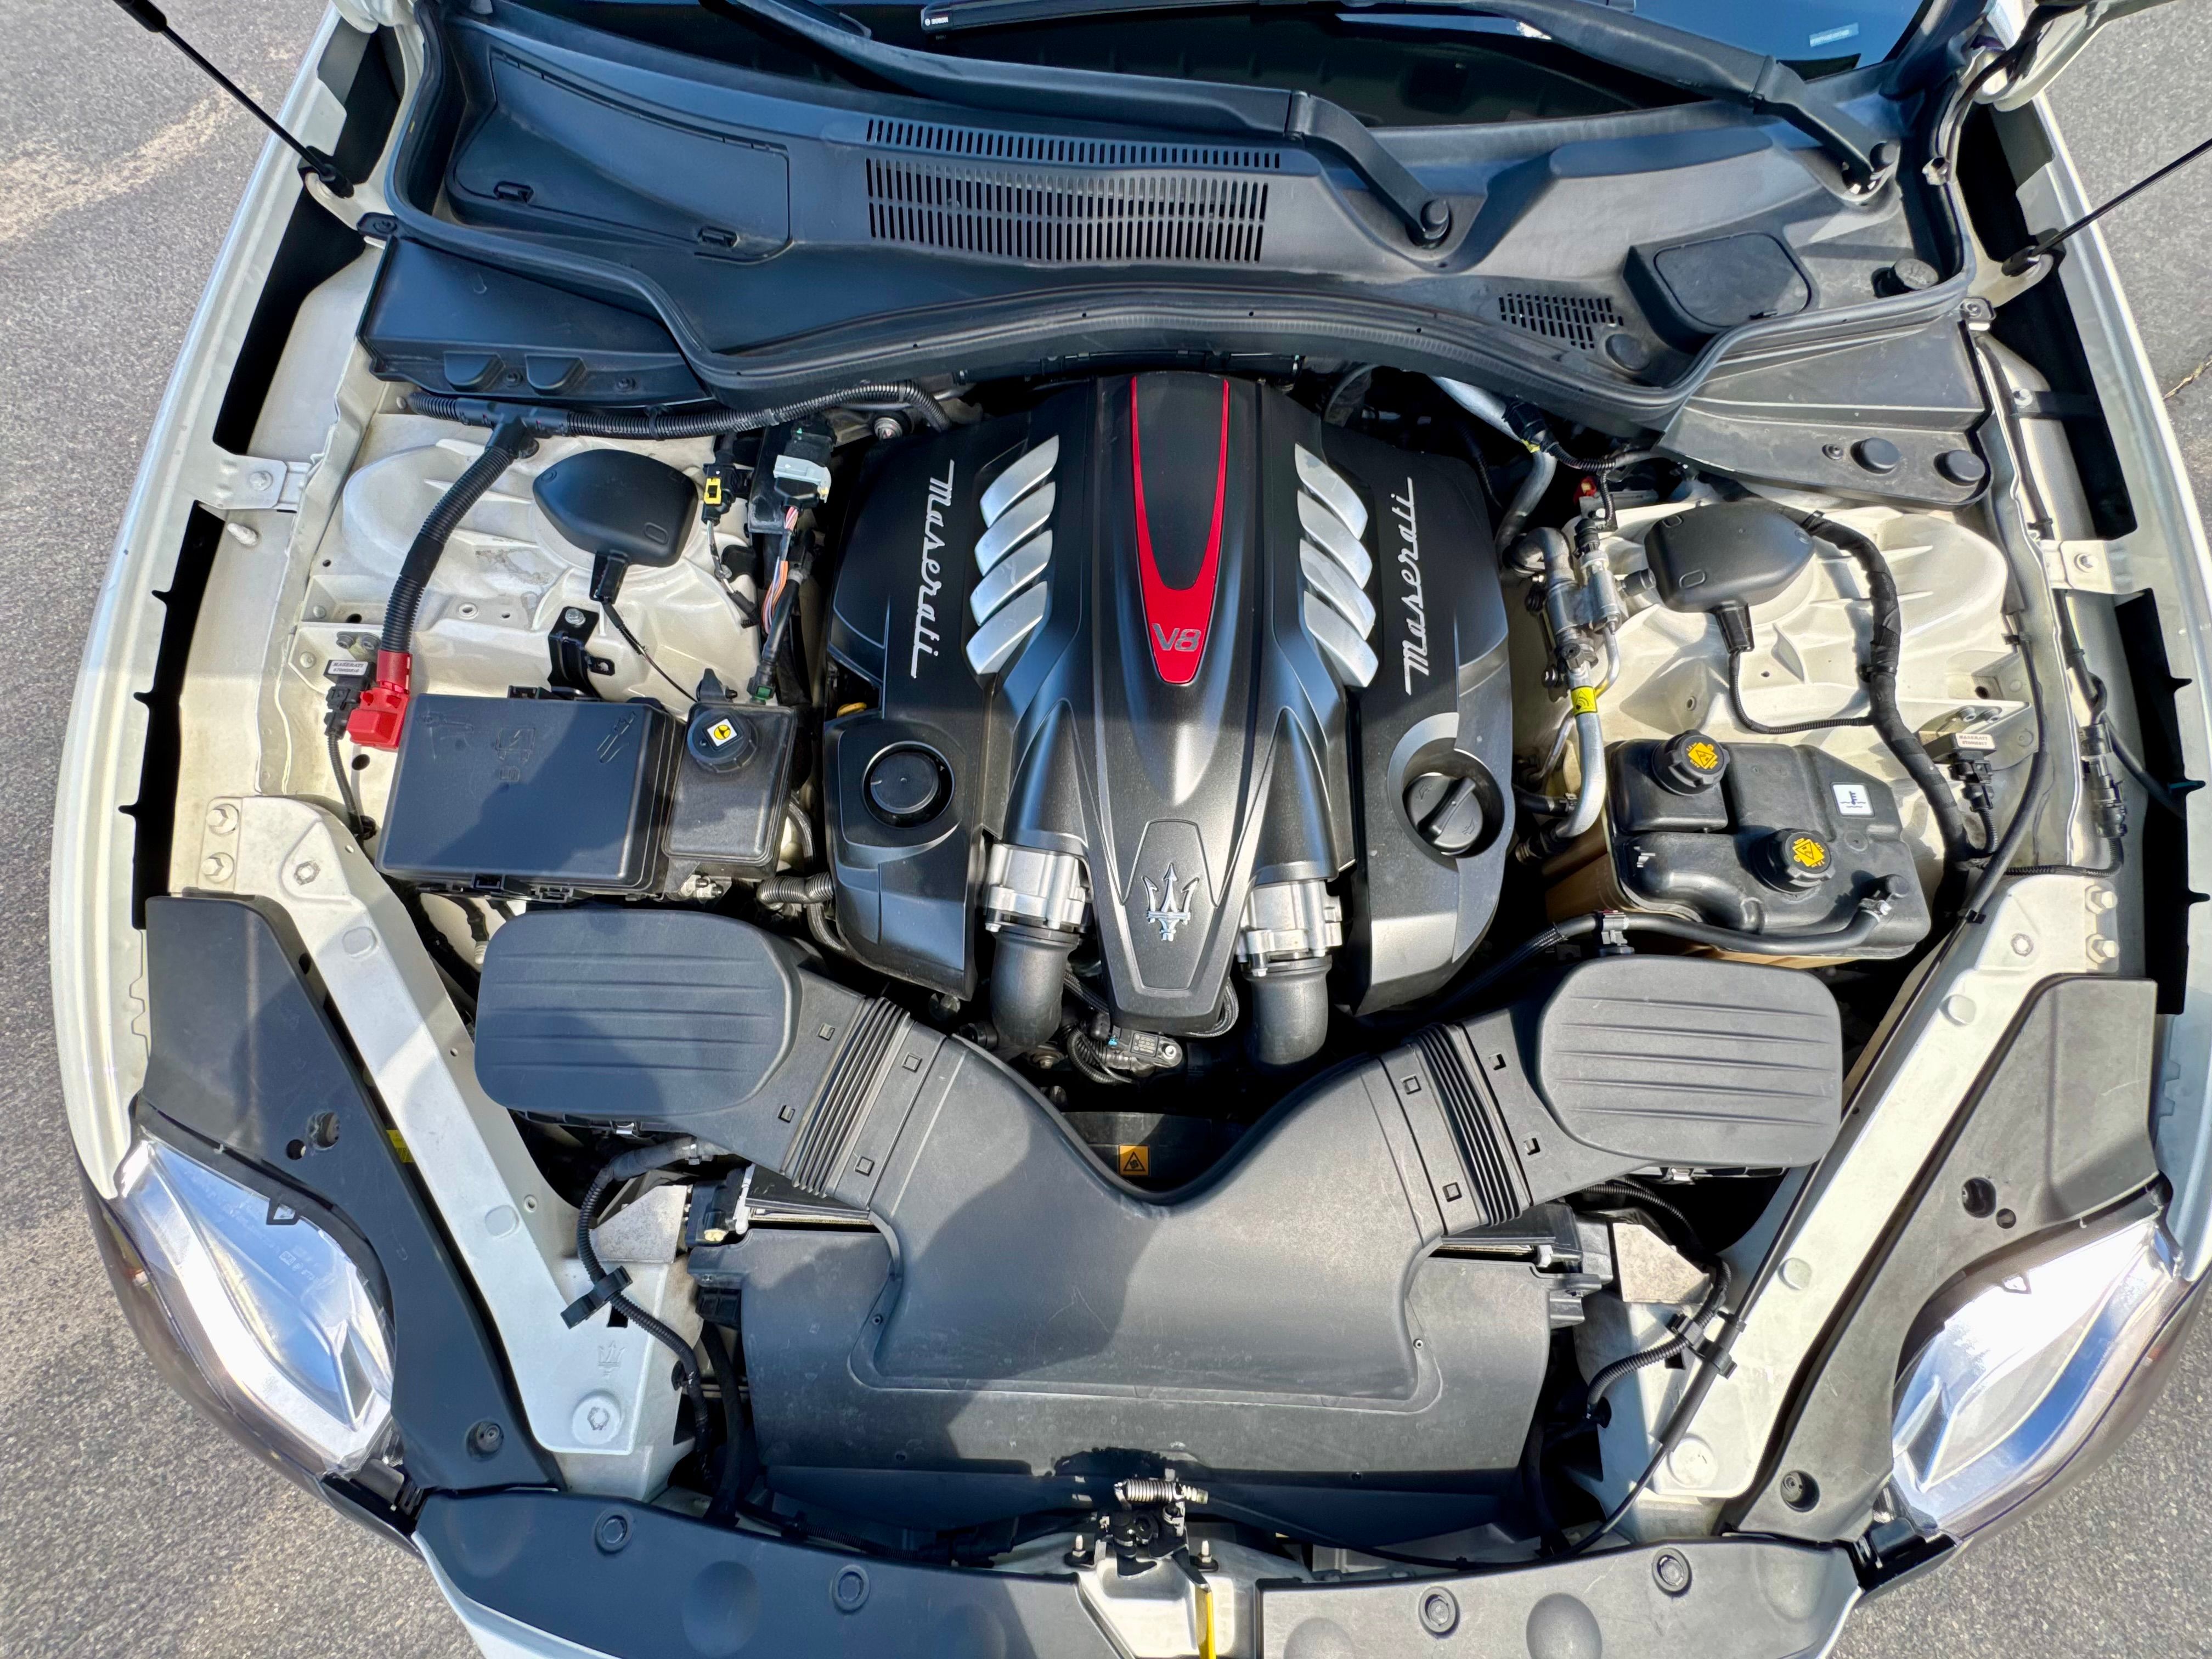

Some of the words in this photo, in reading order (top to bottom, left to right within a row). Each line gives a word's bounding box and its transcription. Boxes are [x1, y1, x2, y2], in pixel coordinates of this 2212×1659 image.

[910, 459, 955, 679] Maserati
[1152, 623, 1201, 652] V8
[1391, 476, 1430, 696] Maserati
